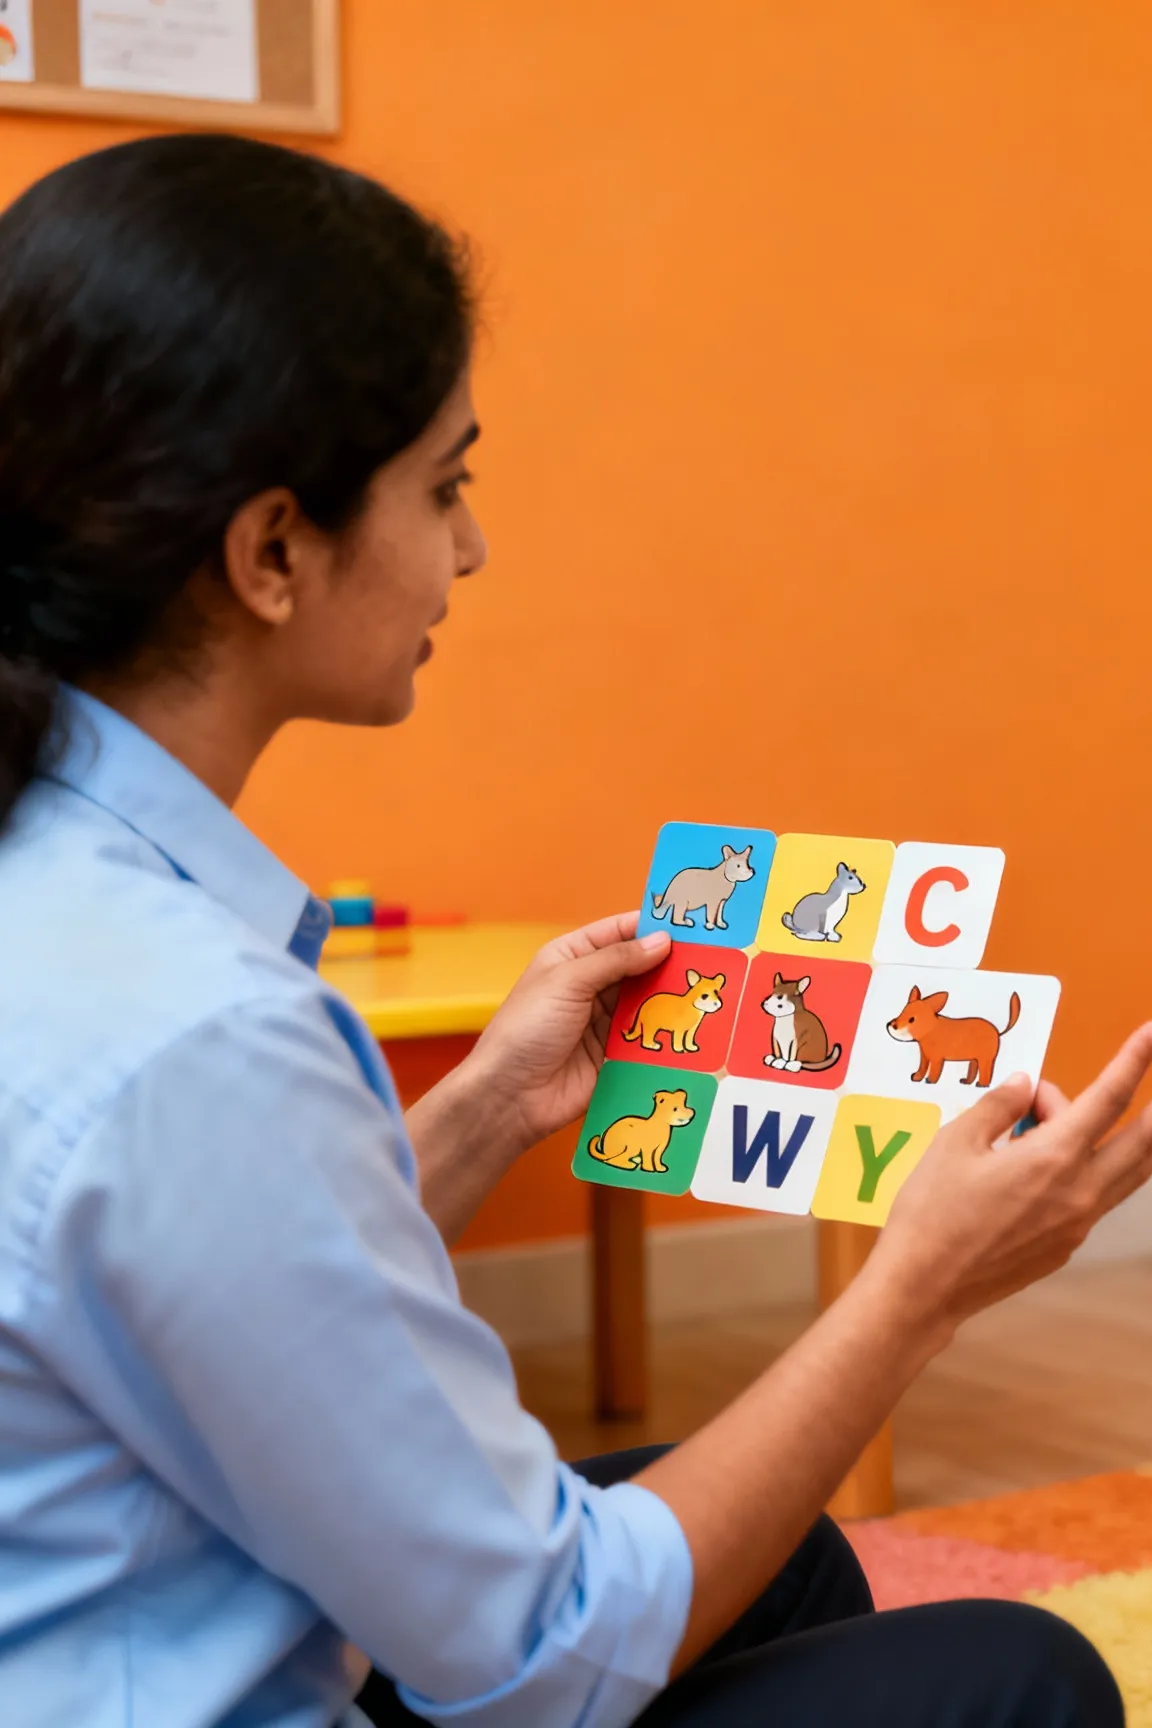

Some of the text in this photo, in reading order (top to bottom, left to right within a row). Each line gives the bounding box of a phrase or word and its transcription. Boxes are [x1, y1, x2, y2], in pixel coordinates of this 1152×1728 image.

[904, 866, 970, 948] C
[732, 1104, 816, 1189] W
[854, 1124, 913, 1203] Y
